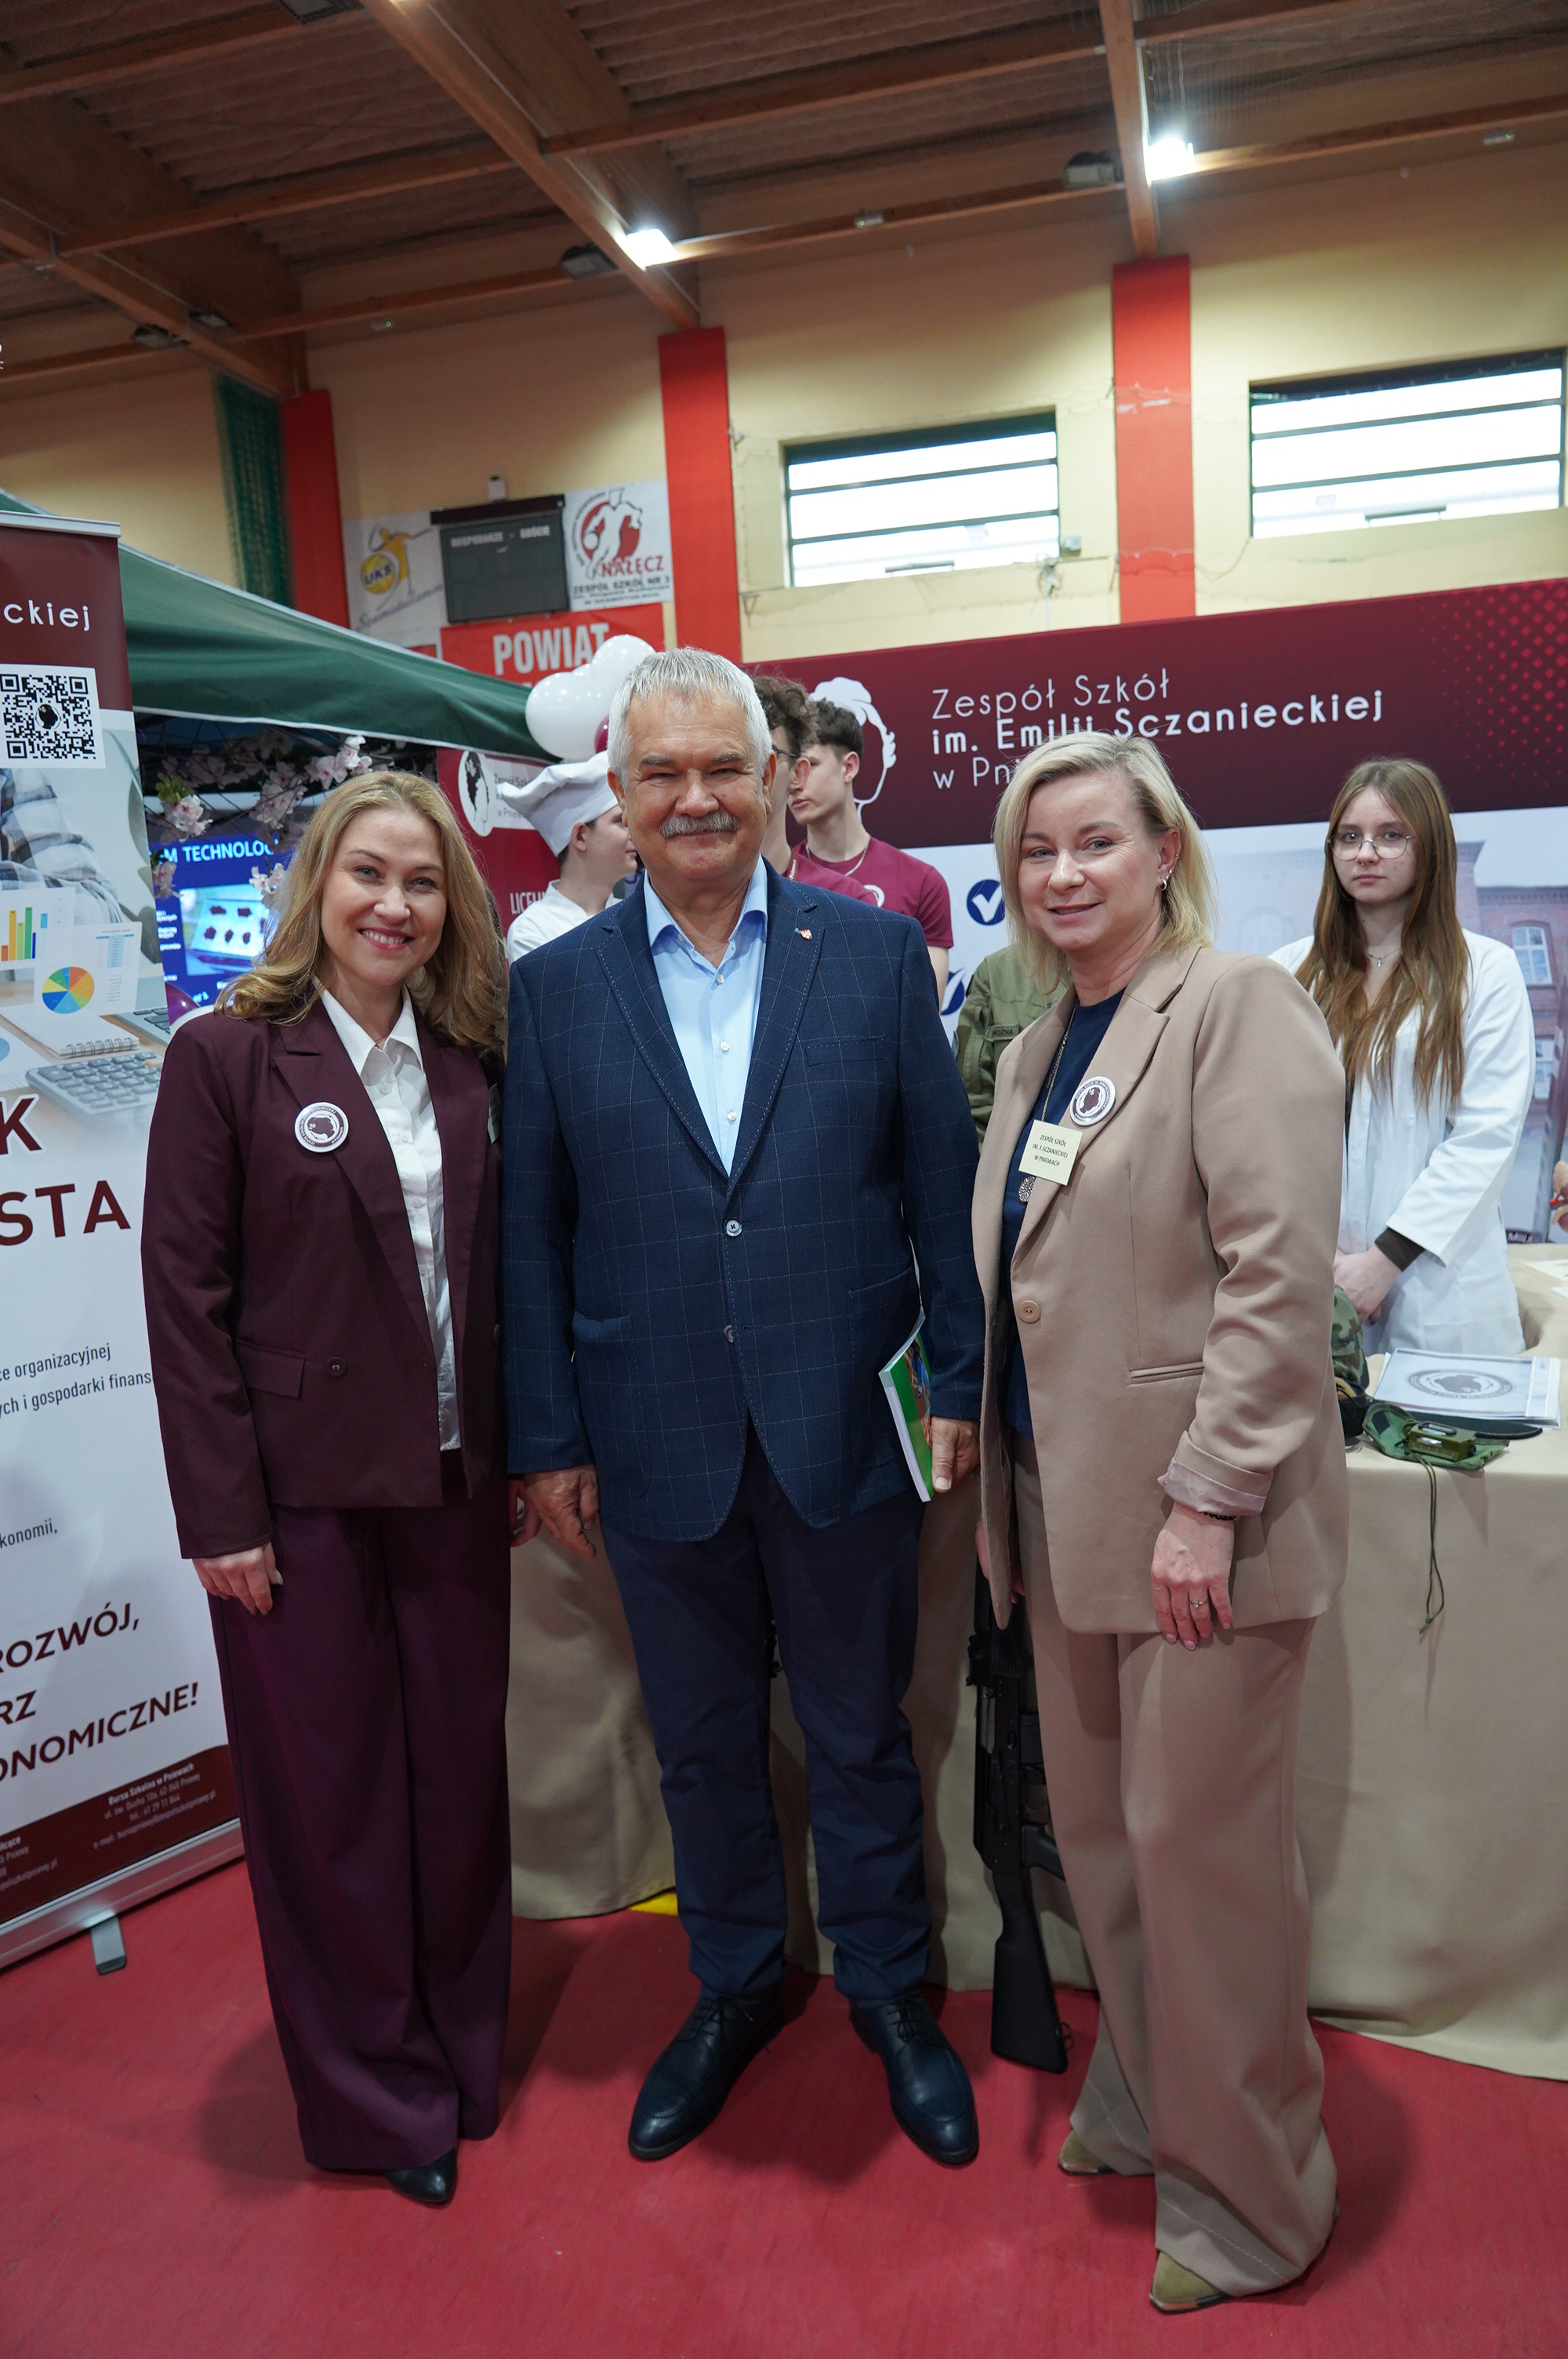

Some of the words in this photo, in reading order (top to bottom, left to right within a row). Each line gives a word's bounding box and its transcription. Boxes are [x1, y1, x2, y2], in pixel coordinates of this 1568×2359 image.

[364, 564, 392, 584] UKS
[4, 600, 89, 631] ckiej
[492, 623, 610, 676] POWIAT
[932, 678, 1055, 719] Zespół
[1073, 667, 1169, 707] Szkół
[932, 729, 978, 754] im.
[1113, 689, 1382, 738] Sczanieckiej
[933, 769, 954, 789] w
[972, 757, 1020, 787] Pn
[1039, 1156, 1060, 1167] PNIEWACH
[0, 1180, 131, 1245] STA
[0, 1367, 10, 1382] e
[15, 1343, 111, 1378] organizacyjnej
[23, 1394, 27, 1409] i
[32, 1376, 104, 1411] gospodarki
[109, 1372, 152, 1390] finans
[0, 1518, 57, 1548] konomii,
